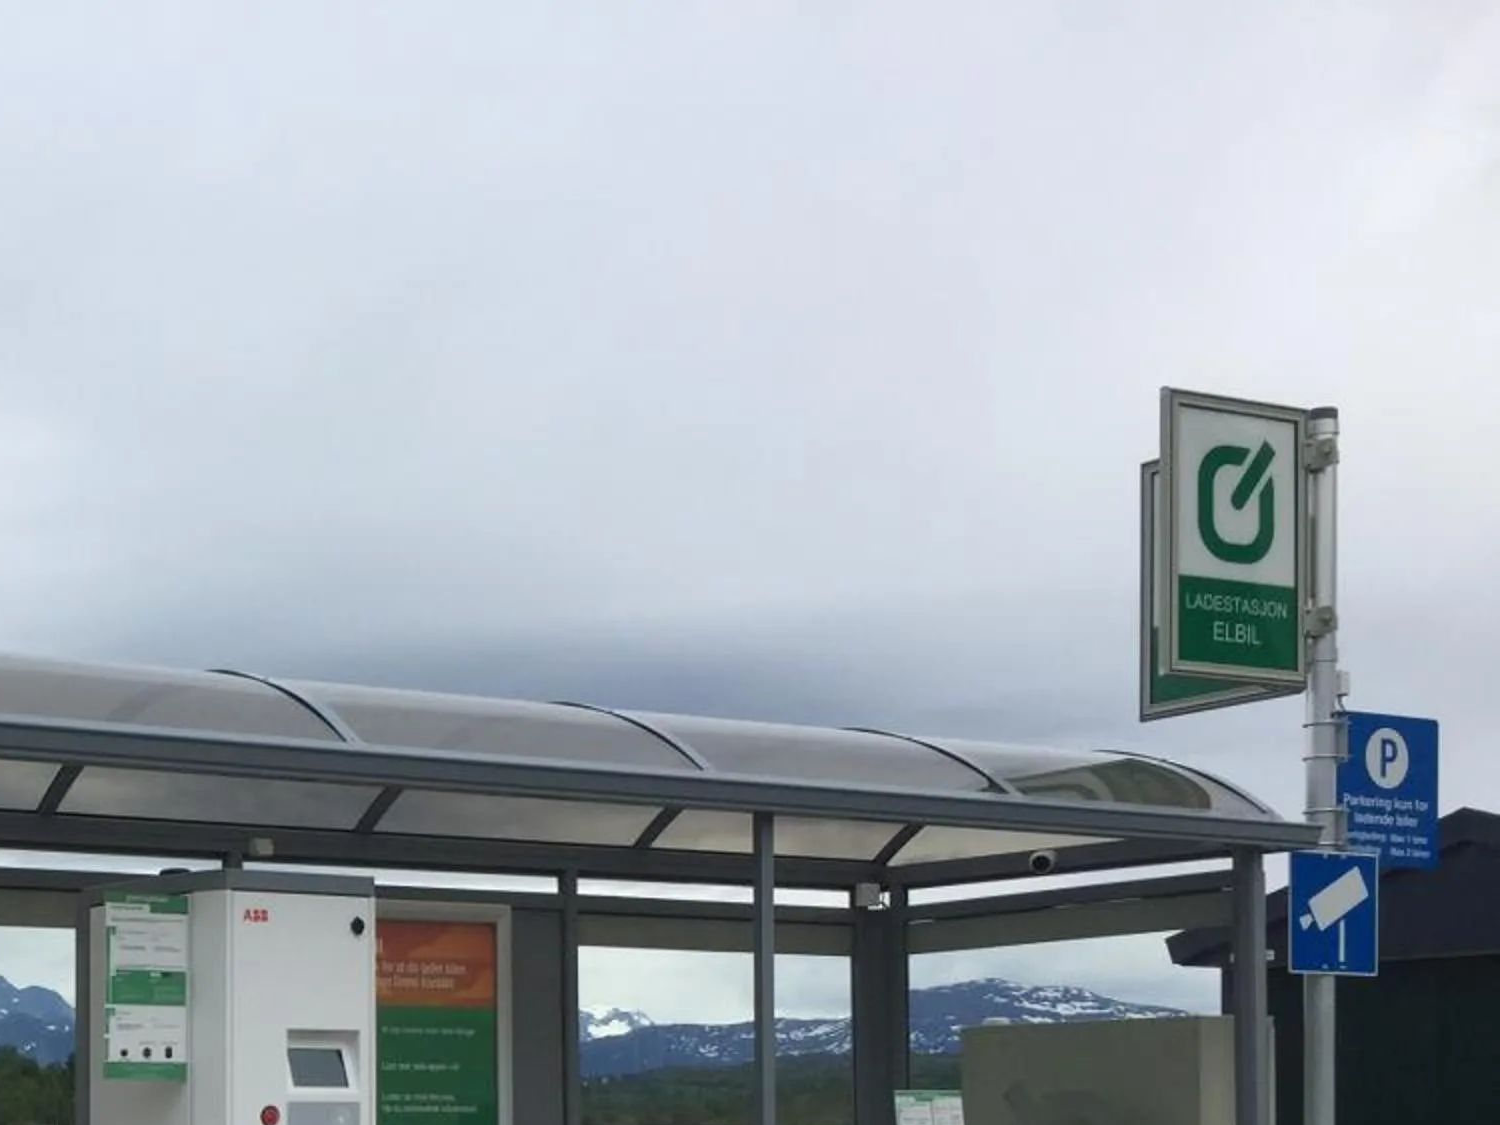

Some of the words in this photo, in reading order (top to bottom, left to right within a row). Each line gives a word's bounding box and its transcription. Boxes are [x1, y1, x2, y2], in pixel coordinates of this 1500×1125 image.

[1185, 592, 1289, 619] LADESTASJON
[1213, 620, 1263, 646] ELBIL
[1380, 737, 1398, 778] P
[244, 908, 269, 922] ABB
